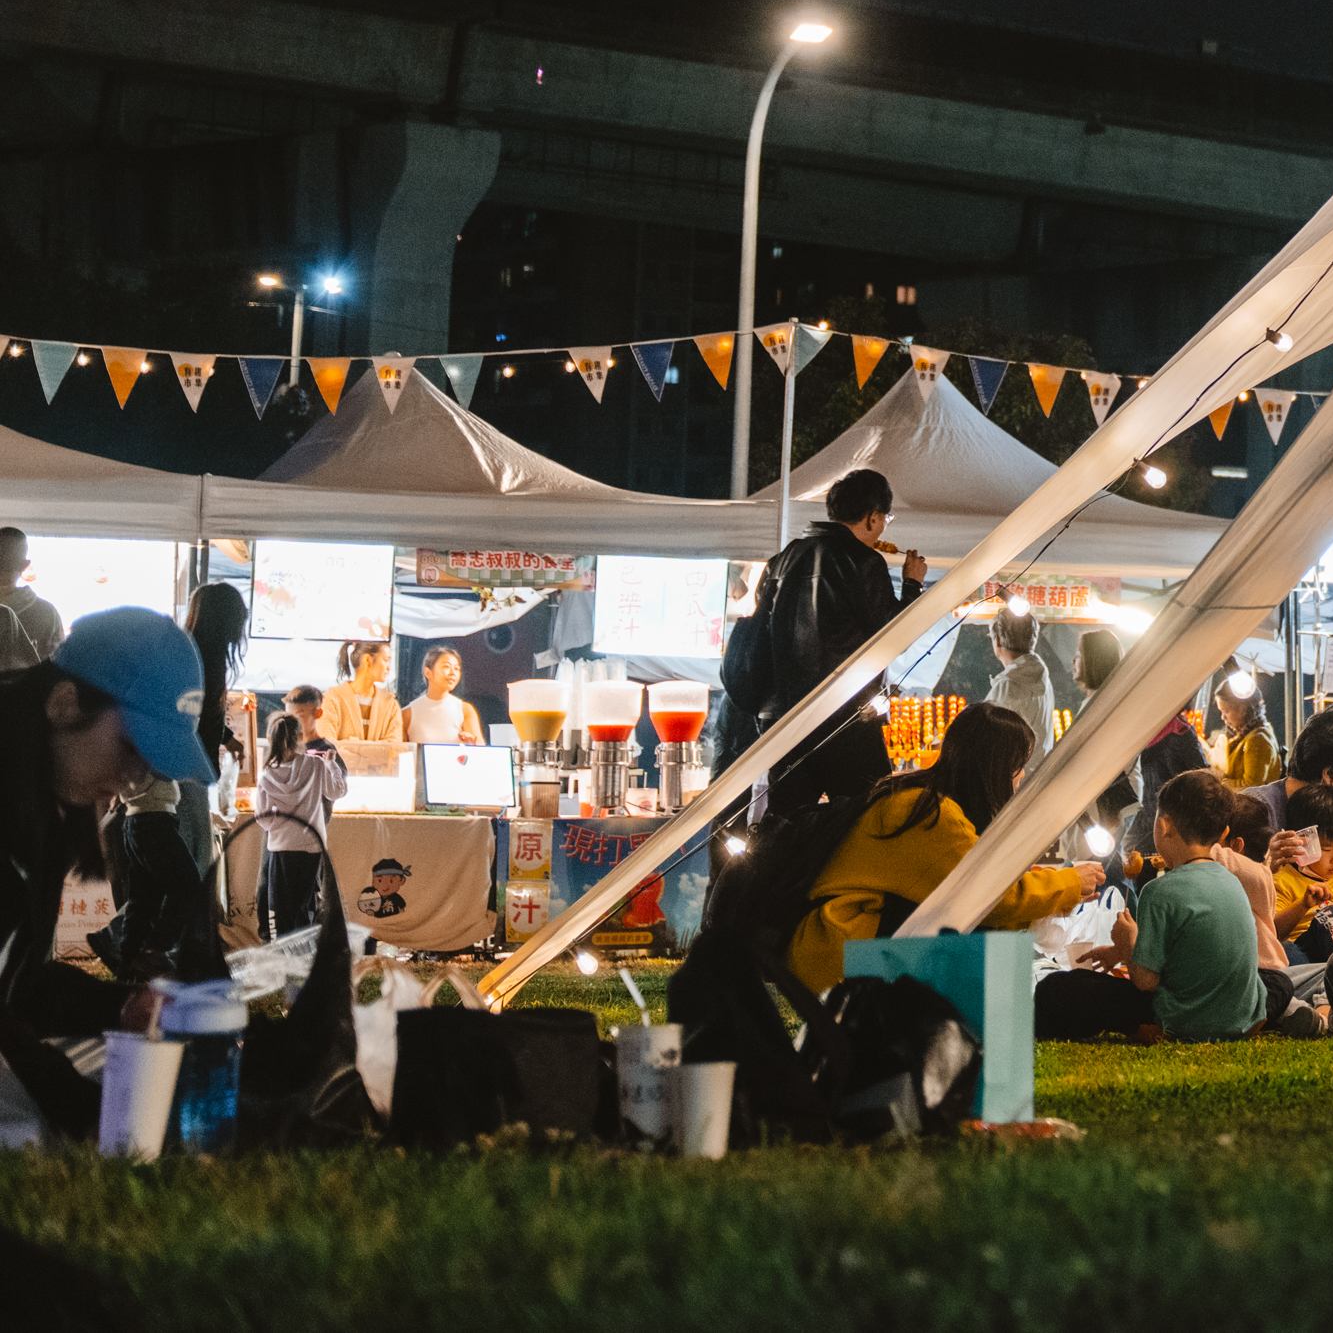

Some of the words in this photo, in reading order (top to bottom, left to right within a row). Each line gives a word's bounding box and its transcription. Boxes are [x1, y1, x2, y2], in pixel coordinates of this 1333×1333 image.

[514, 832, 544, 862] 原
[559, 823, 688, 866] 現打果
[511, 894, 541, 924] 汁
